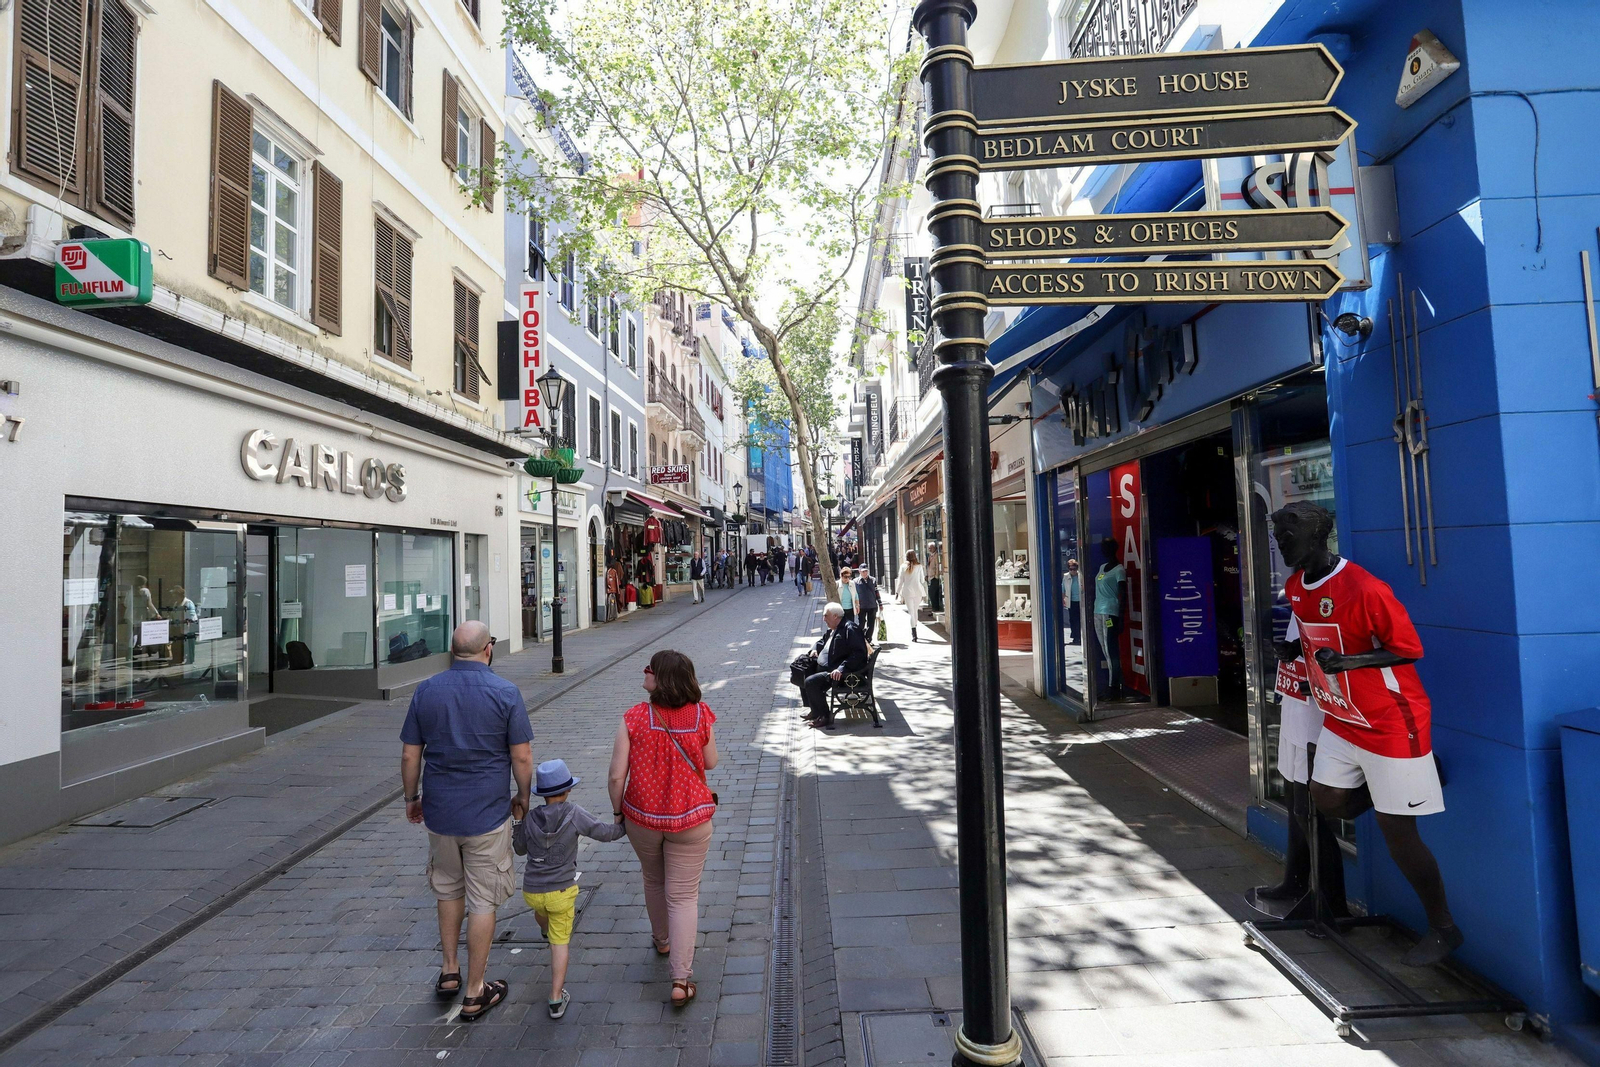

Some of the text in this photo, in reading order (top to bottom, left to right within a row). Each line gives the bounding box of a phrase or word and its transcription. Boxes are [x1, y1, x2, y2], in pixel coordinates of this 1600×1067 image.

[1058, 70, 1249, 104] JYSKE HOUSE
[1401, 63, 1434, 94] On Guard
[983, 126, 1203, 159] BEDLAM COURT
[989, 220, 1239, 248] SHOPS & OFFICES
[61, 280, 124, 296] FUJIFILM
[989, 270, 1322, 295] ACCESS TO IRISH TOWN
[523, 291, 541, 428] TOSHIBA
[240, 429, 408, 502] CARLOS
[652, 465, 688, 474] RED SKINS
[557, 490, 577, 509] ALPE
[1120, 474, 1145, 675] SALE
[1164, 571, 1203, 643] Sport City
[1278, 674, 1300, 693] £39.9
